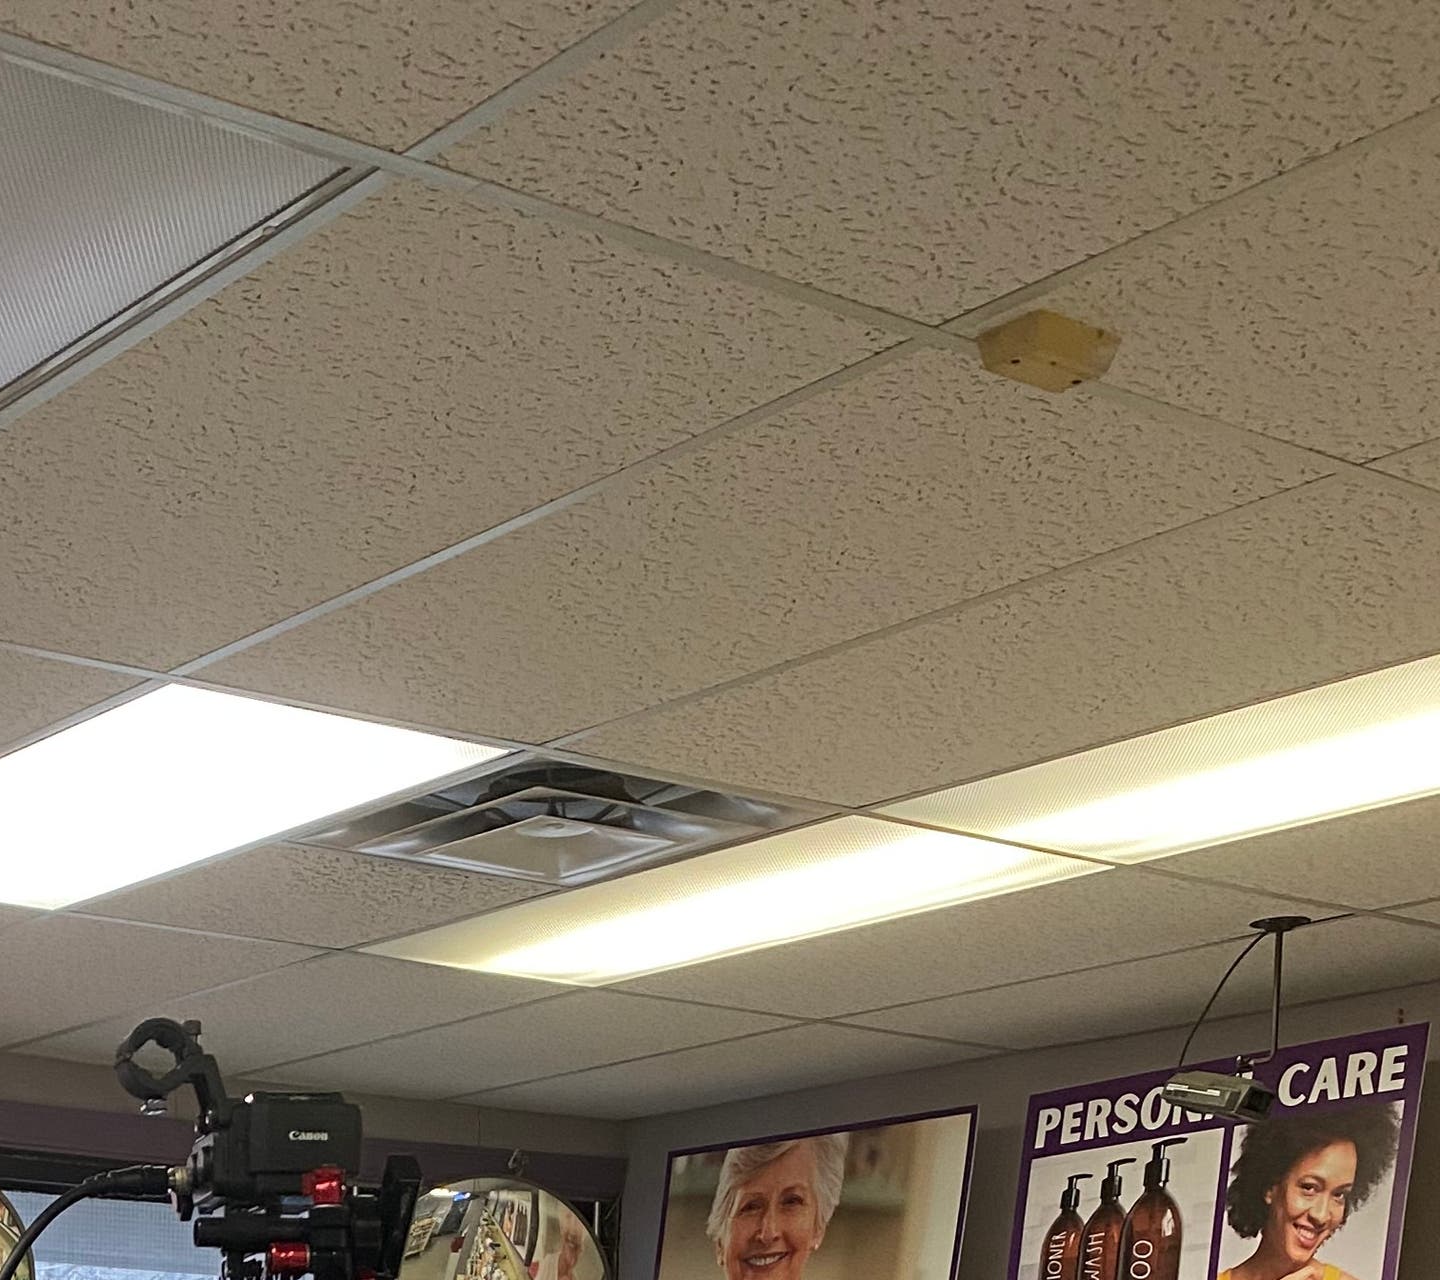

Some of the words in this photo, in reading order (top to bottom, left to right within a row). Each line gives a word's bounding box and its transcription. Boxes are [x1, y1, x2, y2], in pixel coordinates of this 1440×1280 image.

[1034, 1071, 1254, 1149] PERSON
[1278, 1045, 1408, 1107] CARE
[289, 1130, 329, 1141] Canon
